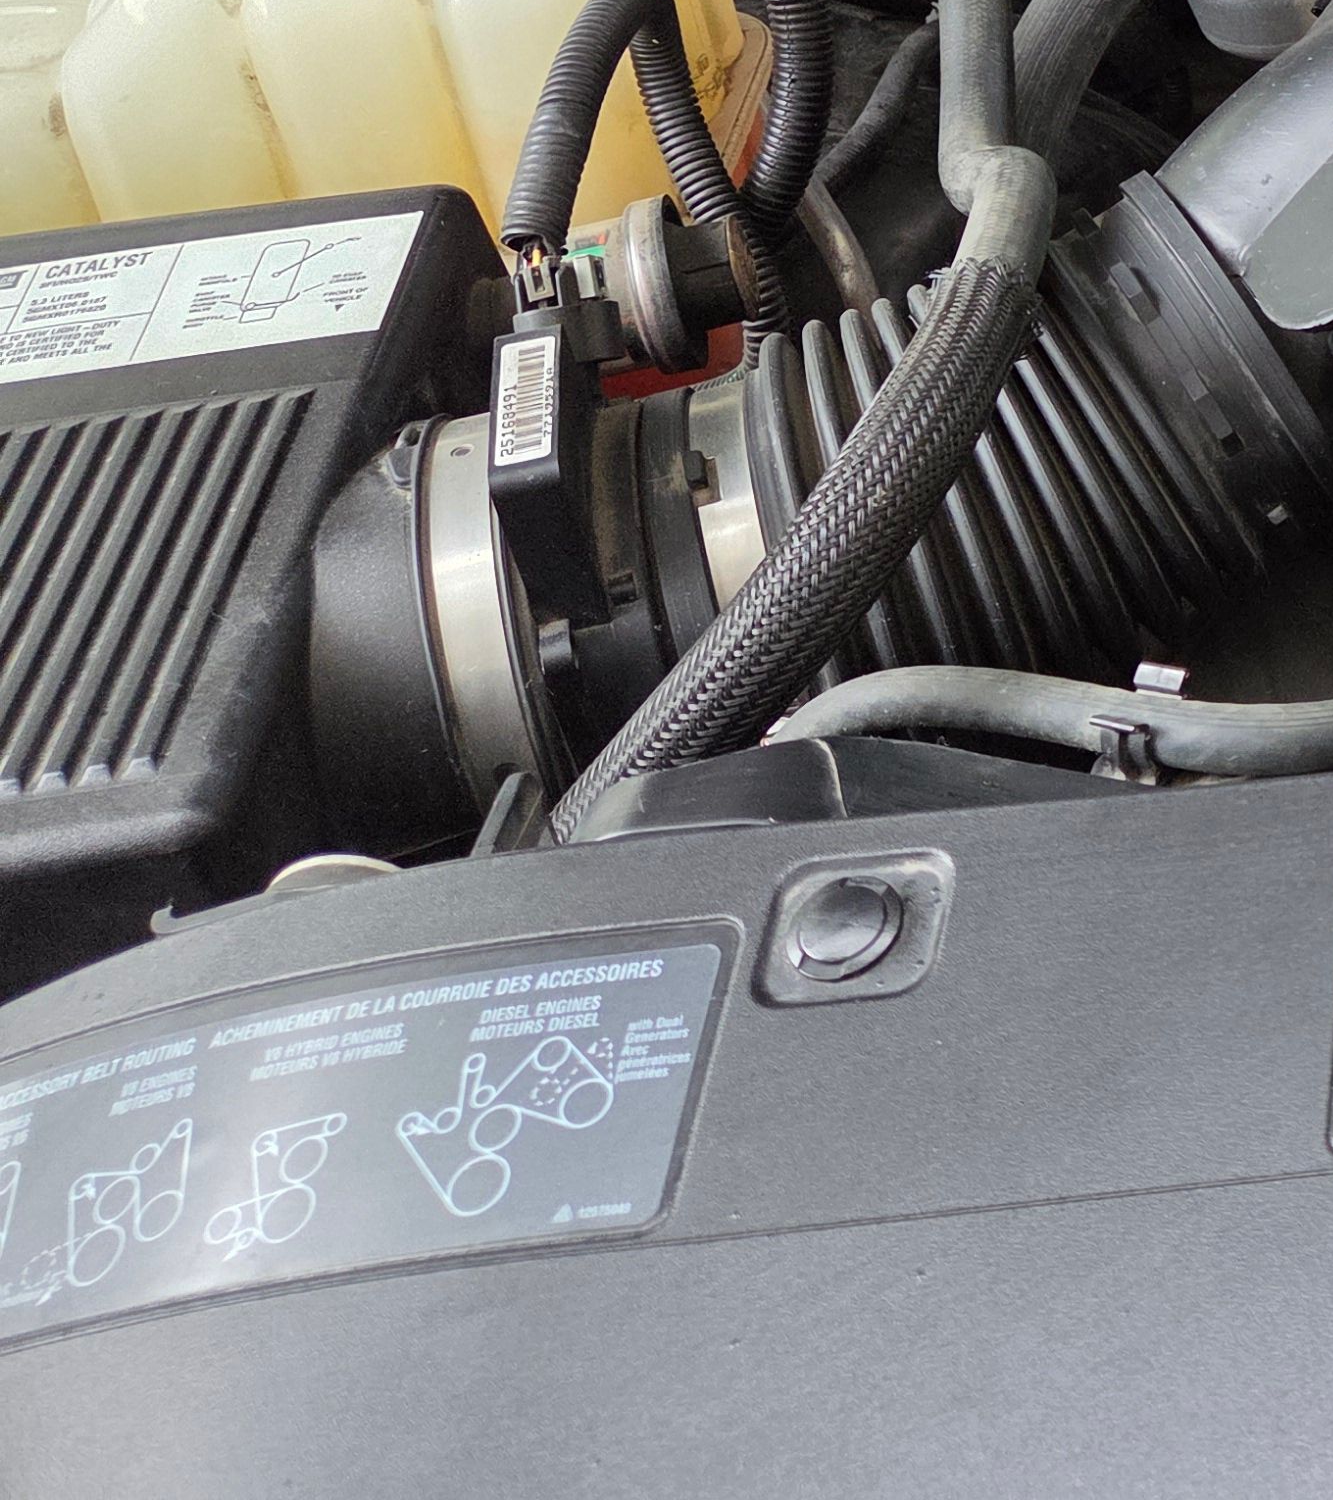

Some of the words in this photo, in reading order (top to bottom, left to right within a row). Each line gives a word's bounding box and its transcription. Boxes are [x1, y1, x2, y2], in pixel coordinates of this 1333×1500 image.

[45, 252, 153, 279] CATALYST
[50, 291, 90, 303] LITERS
[6, 345, 60, 357] CERTIFIED
[61, 341, 75, 349] TO
[78, 338, 98, 347] THE
[24, 330, 50, 340] NEW
[29, 333, 81, 347] CERTIFIED
[83, 330, 105, 339] FOR
[33, 349, 68, 359] MEETS
[70, 346, 89, 355] ALL
[500, 384, 517, 457] 25168491
[208, 1006, 344, 1049] ACHEMINEMENT
[345, 1000, 371, 1020] DE
[373, 995, 396, 1015] LA
[399, 979, 493, 1011] COURROIE
[494, 975, 533, 996] DES
[535, 959, 665, 990] ACCESSOIRES
[479, 1005, 530, 1024] DIESEL
[536, 996, 602, 1016] ENGINES
[284, 1034, 340, 1059] HYBRID
[340, 1023, 405, 1048] ENGINES
[470, 1019, 545, 1042] MOTEURS
[547, 1012, 601, 1032] DIESEL
[81, 1057, 123, 1084] BELT
[120, 1037, 197, 1073] ROUTING
[250, 1056, 319, 1082] MOTEURS
[342, 1039, 408, 1063] HYBRIDE
